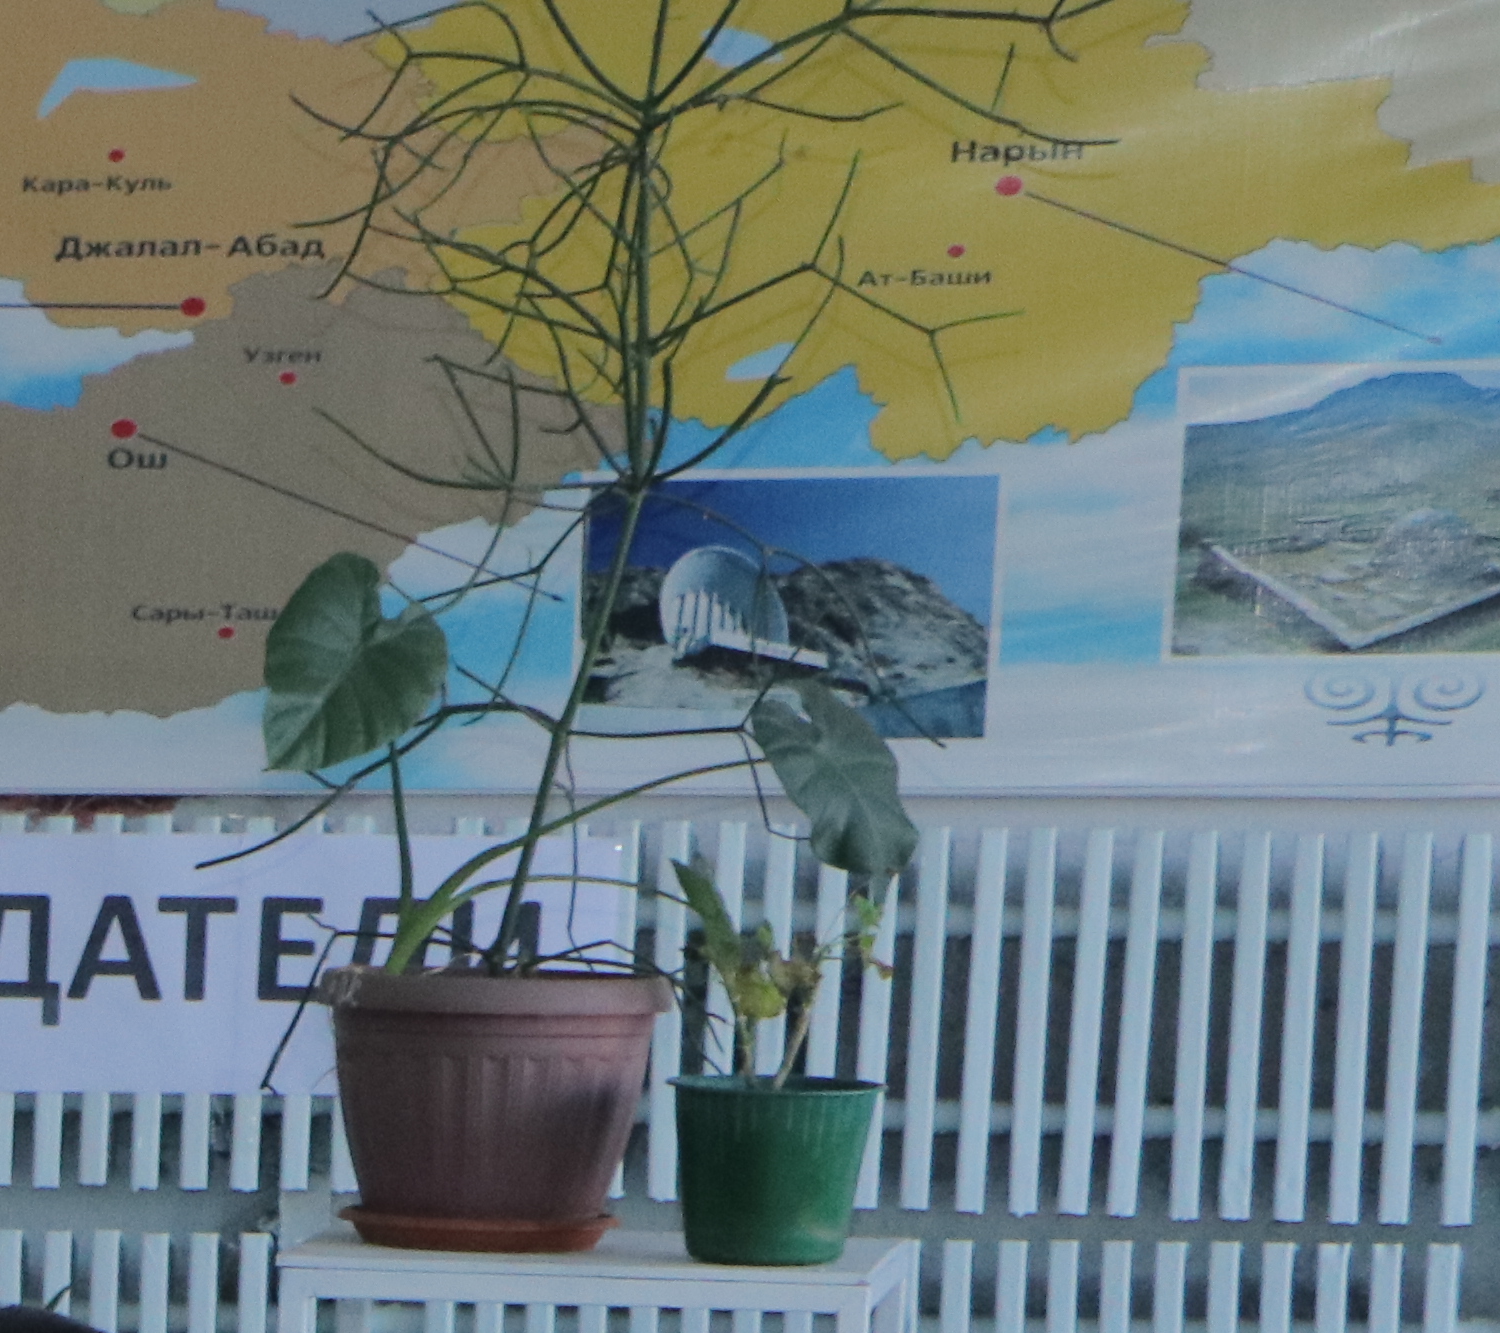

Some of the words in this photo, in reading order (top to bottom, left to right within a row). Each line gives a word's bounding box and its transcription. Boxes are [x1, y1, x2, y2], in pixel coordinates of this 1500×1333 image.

[950, 138, 1083, 165] Нарын
[22, 173, 172, 195] Кара-Куль
[54, 234, 326, 263] Джалал-Абад
[857, 268, 993, 288] Ат-Баши
[243, 346, 323, 368] Узген
[106, 446, 169, 472] Ош
